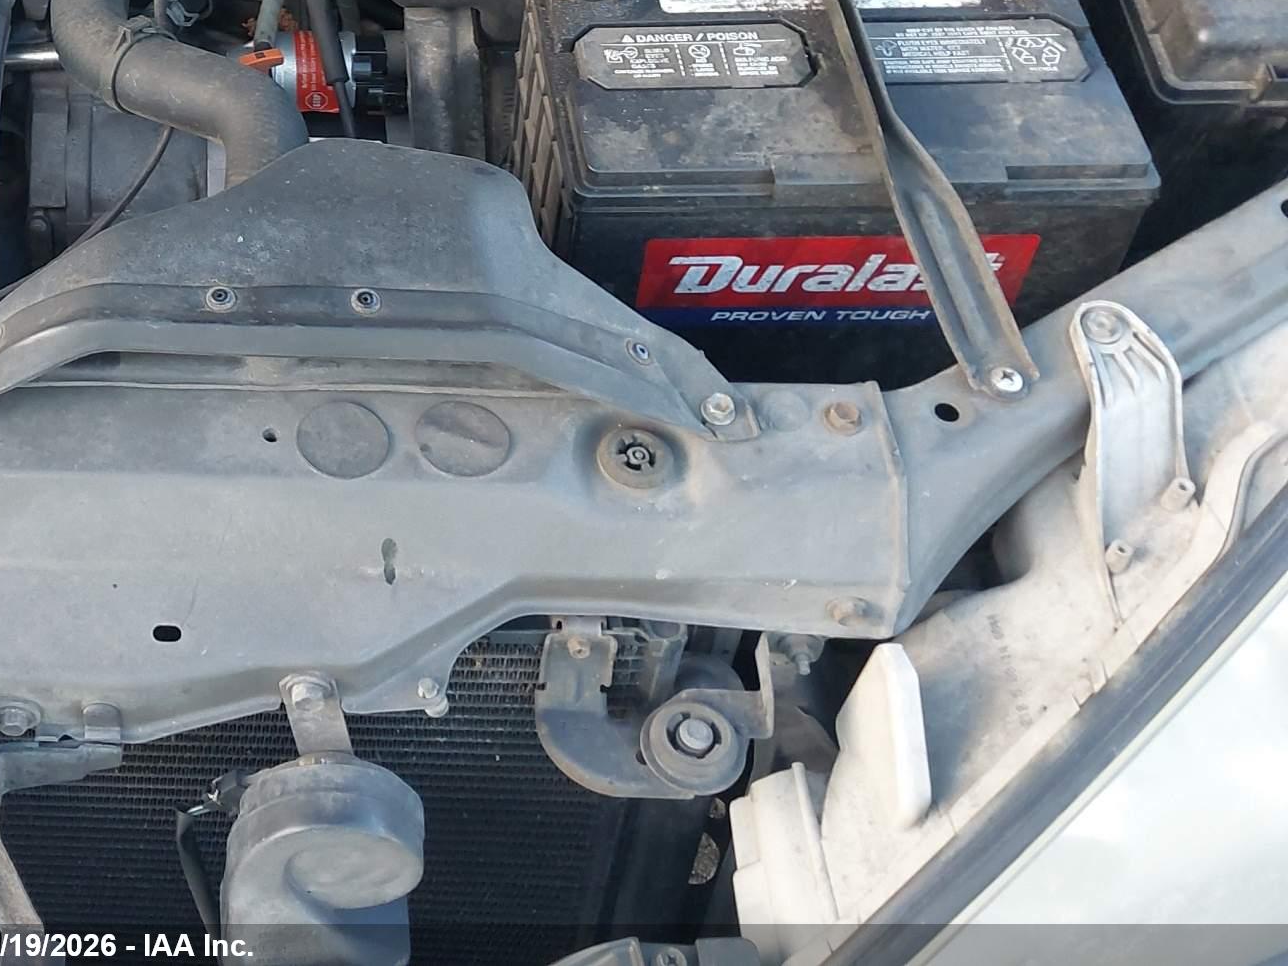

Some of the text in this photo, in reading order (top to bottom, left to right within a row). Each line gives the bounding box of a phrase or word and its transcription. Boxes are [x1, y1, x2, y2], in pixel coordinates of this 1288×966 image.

[635, 31, 759, 43] DANGER / POISON
[711, 309, 931, 322] PROVEN TOUGH
